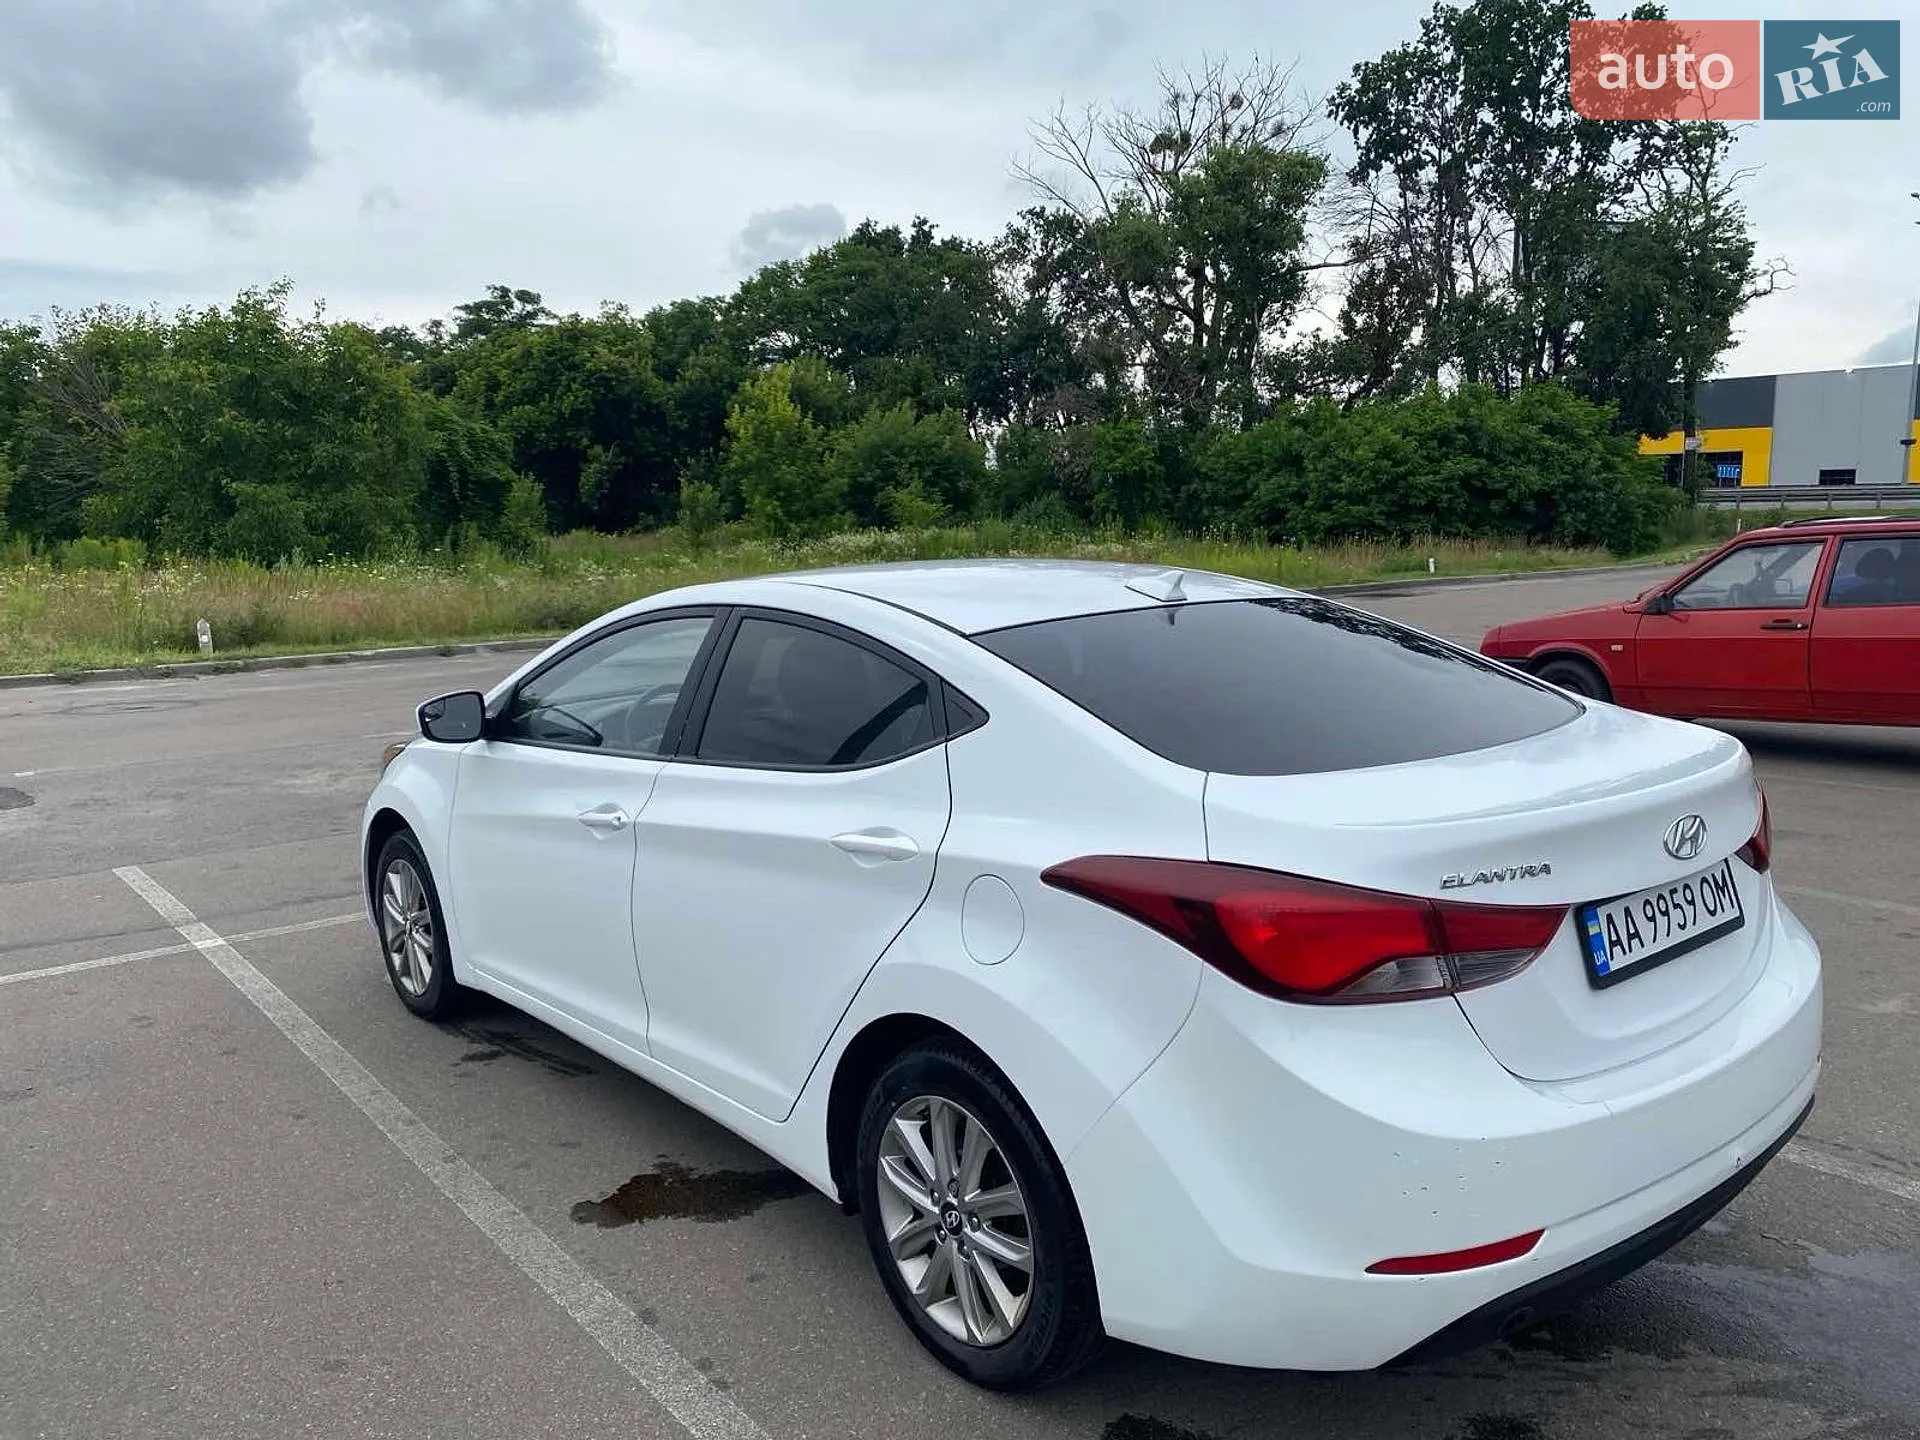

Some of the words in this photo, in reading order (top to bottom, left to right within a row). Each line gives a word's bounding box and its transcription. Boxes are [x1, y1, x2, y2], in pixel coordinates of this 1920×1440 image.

[1440, 861, 1552, 889] ELANTRA
[1605, 906, 1645, 961] AA
[1642, 883, 1697, 944] 9959
[1700, 868, 1735, 917] OM
[1593, 951, 1608, 966] UA
